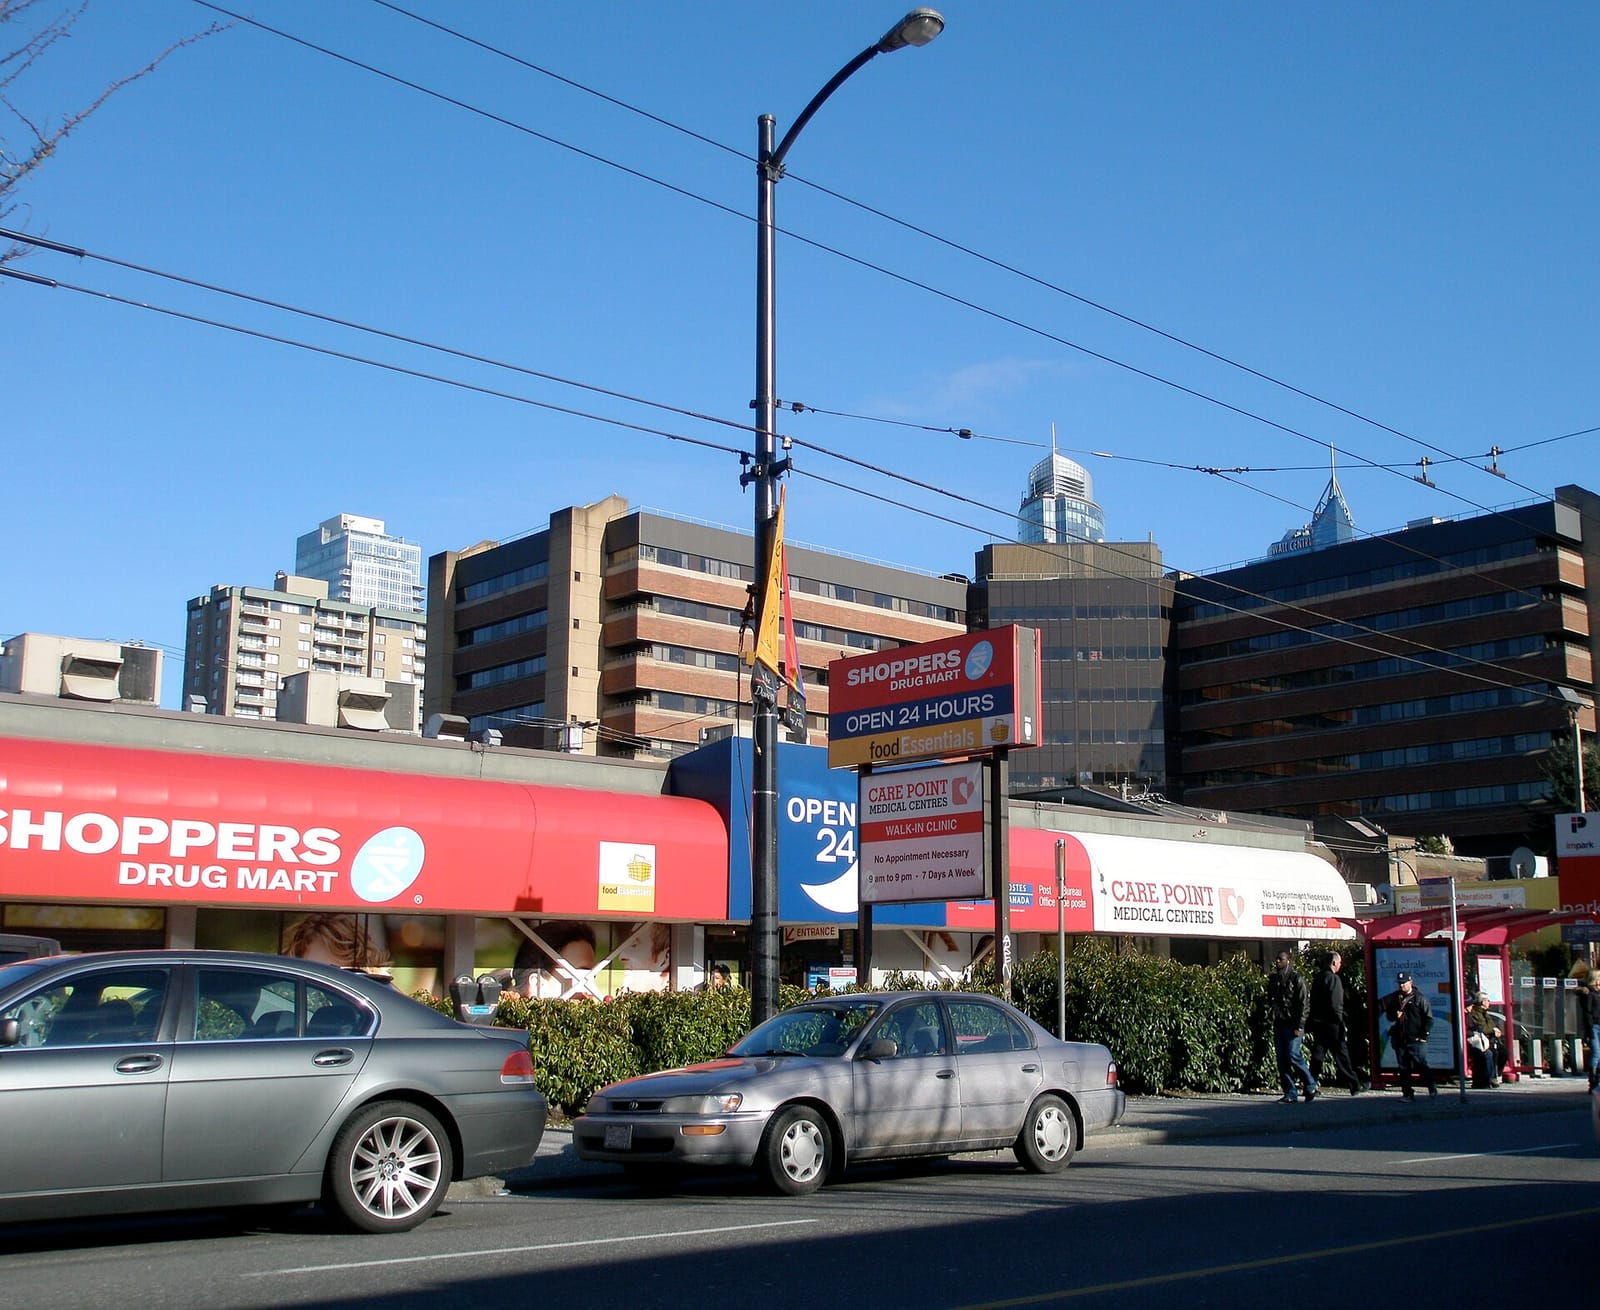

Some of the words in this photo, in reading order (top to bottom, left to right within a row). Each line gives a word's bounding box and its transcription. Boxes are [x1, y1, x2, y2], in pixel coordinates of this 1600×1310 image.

[847, 649, 961, 686] SHOPPERS
[890, 675, 923, 691] DRUG
[926, 669, 961, 685] MART
[846, 710, 894, 733] OPEN
[899, 706, 920, 725] 24
[926, 694, 994, 721] HOURS
[868, 784, 904, 803] CARE
[906, 779, 949, 799] POINT
[787, 796, 856, 827] OPEN
[869, 801, 907, 815] MEDICAL
[909, 797, 948, 811] CENTRES
[886, 823, 924, 836] WALK-IN
[926, 819, 958, 833] CLINIC
[0, 808, 342, 866] HOPPERS
[816, 827, 856, 864] 24
[874, 855, 884, 864] No
[886, 851, 930, 865] Appointment
[932, 849, 970, 860] Necessary
[118, 861, 228, 889] DRUG
[237, 866, 339, 892] MART
[868, 875, 873, 883] 9
[874, 875, 885, 883] am
[886, 874, 894, 882] to
[895, 873, 900, 882] 9
[901, 873, 912, 883] pm
[922, 871, 926, 880] 7
[928, 870, 947, 881] Days
[948, 869, 954, 878] A
[955, 868, 976, 878] Week
[1038, 884, 1052, 895] Post
[1111, 880, 1159, 903] CARE
[1161, 883, 1214, 906] POINT
[1262, 890, 1272, 898] No
[1272, 891, 1307, 900] Appointment
[1307, 892, 1334, 903] Necessary
[1038, 896, 1056, 908] Office
[1113, 906, 1164, 922] MEDICAL
[1166, 909, 1214, 924] CENTRES
[1277, 916, 1305, 926] WALK-IN
[1306, 918, 1327, 927] CLINIC
[796, 927, 836, 937] ENTRANCE
[1380, 959, 1426, 969] Cathedrals
[1414, 970, 1446, 978] Science
